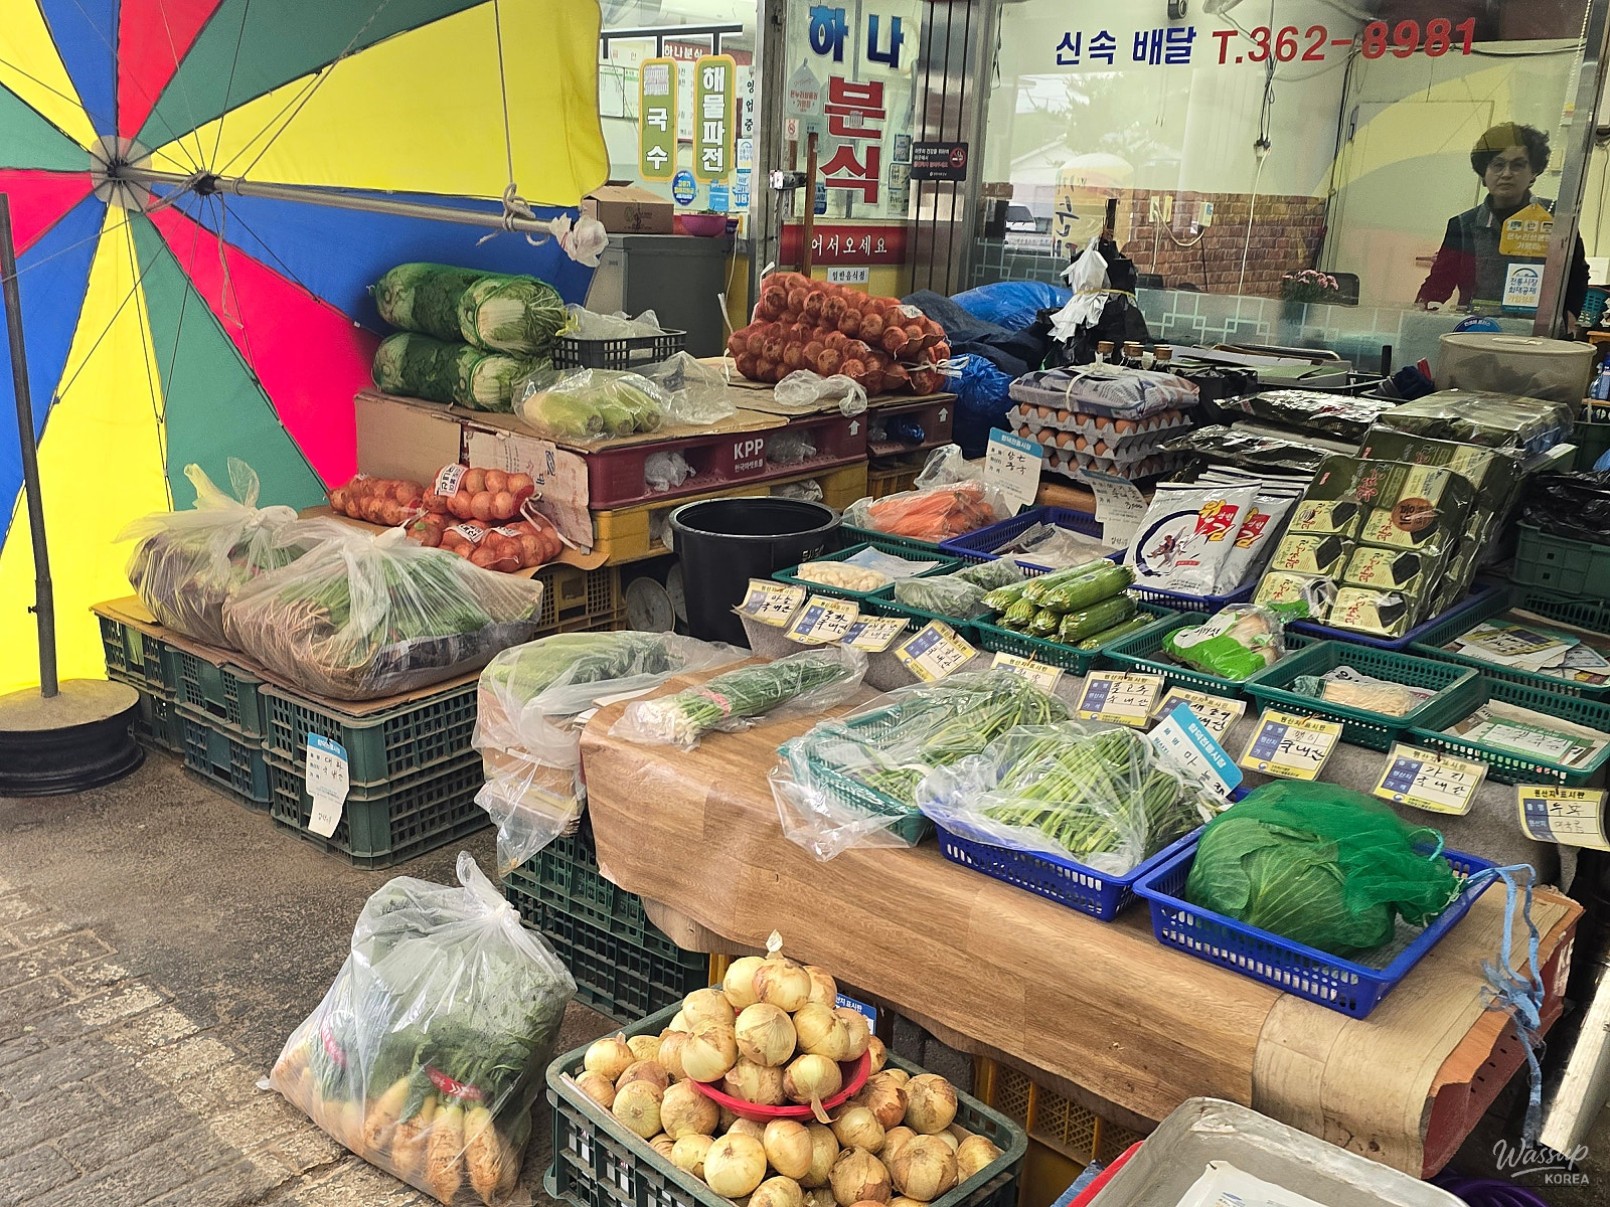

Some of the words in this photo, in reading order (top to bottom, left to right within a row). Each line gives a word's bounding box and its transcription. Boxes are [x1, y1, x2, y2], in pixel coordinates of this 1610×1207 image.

[809, 5, 904, 68] 하나
[1055, 30, 1117, 66] 신속
[1132, 26, 1197, 66] 배달
[1211, 17, 1477, 64] T.362-8981
[819, 75, 886, 205] 분식
[811, 234, 888, 257] 어서오세요
[734, 438, 764, 460] KPP
[1187, 722, 1227, 768] 합덕전통시장
[1280, 738, 1325, 761] 국내산
[1416, 775, 1466, 795] 국내산
[1534, 789, 1556, 799] 원산지
